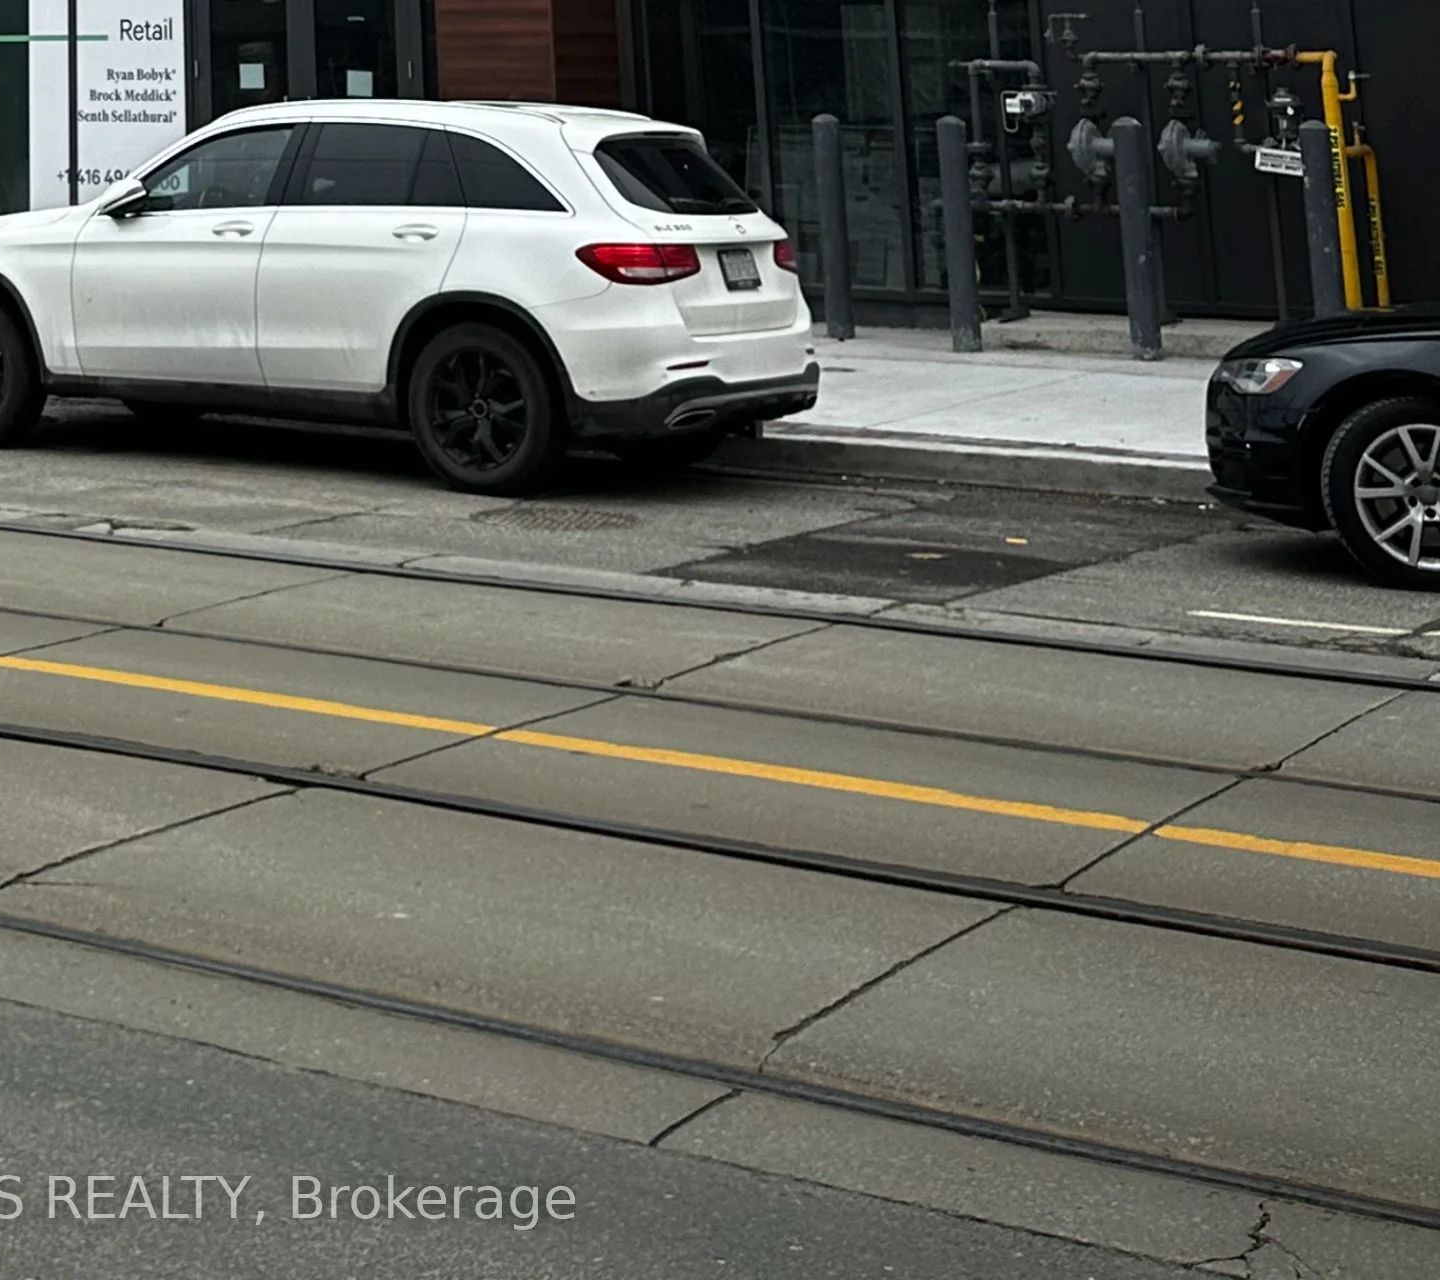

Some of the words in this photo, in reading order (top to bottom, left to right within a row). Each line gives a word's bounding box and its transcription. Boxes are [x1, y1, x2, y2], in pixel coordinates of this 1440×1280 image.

[119, 17, 173, 41] Retail
[106, 68, 135, 83] Ryan
[89, 89, 122, 102] Brock
[77, 110, 109, 123] Senth
